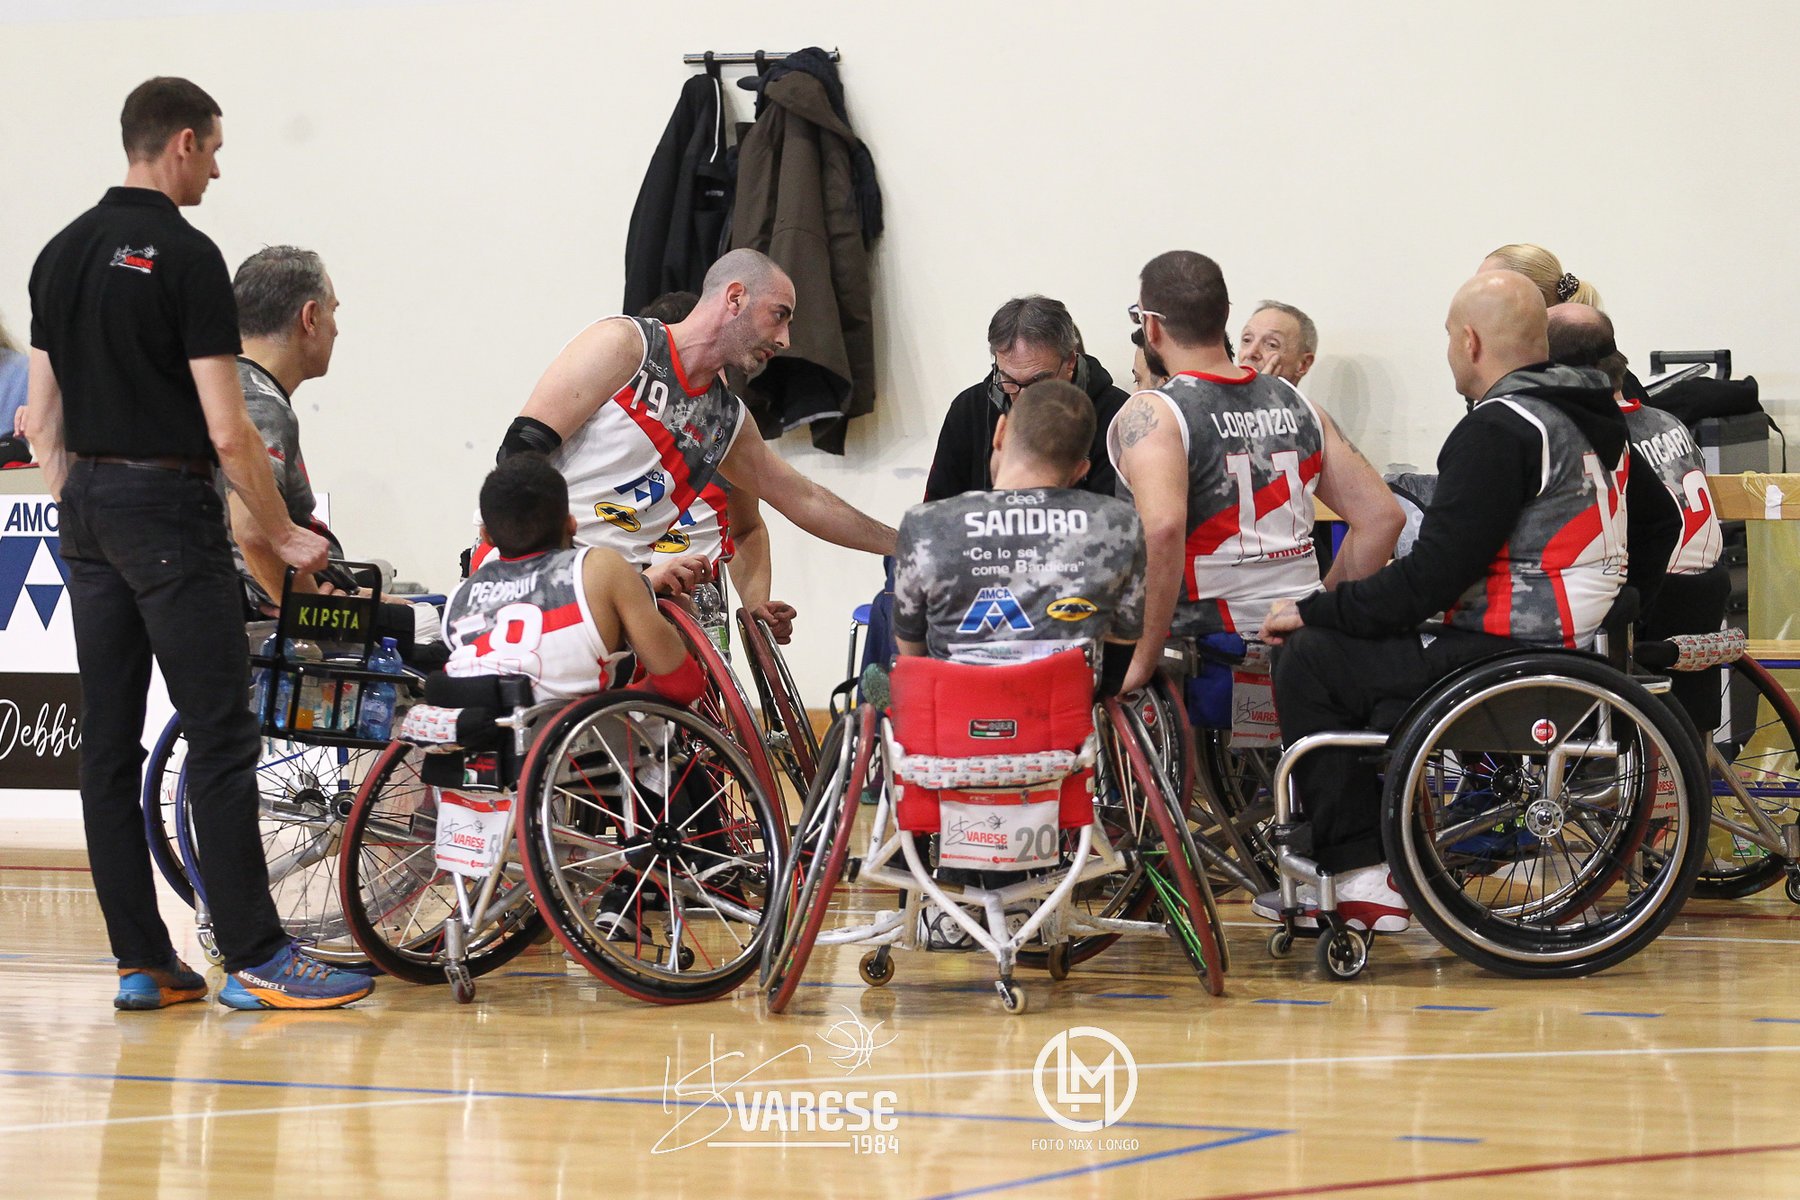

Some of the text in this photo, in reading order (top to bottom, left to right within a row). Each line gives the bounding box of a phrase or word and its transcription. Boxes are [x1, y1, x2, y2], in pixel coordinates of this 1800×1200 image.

[630, 370, 669, 421] 19
[1211, 408, 1298, 439] LORENZO
[4, 502, 60, 532] AMC
[964, 508, 1088, 537] SANDRO
[997, 548, 1011, 558] lo
[1017, 547, 1038, 558] sei
[971, 564, 1009, 576] come
[977, 588, 1012, 600] AMCA
[298, 606, 360, 630] KIPSTA
[1251, 711, 1280, 722] VARES
[0, 699, 82, 761] Debbi
[452, 833, 486, 849] VARESE
[966, 831, 1008, 845] VARESE
[1015, 824, 1057, 862] 20
[237, 970, 288, 993] MERRELL
